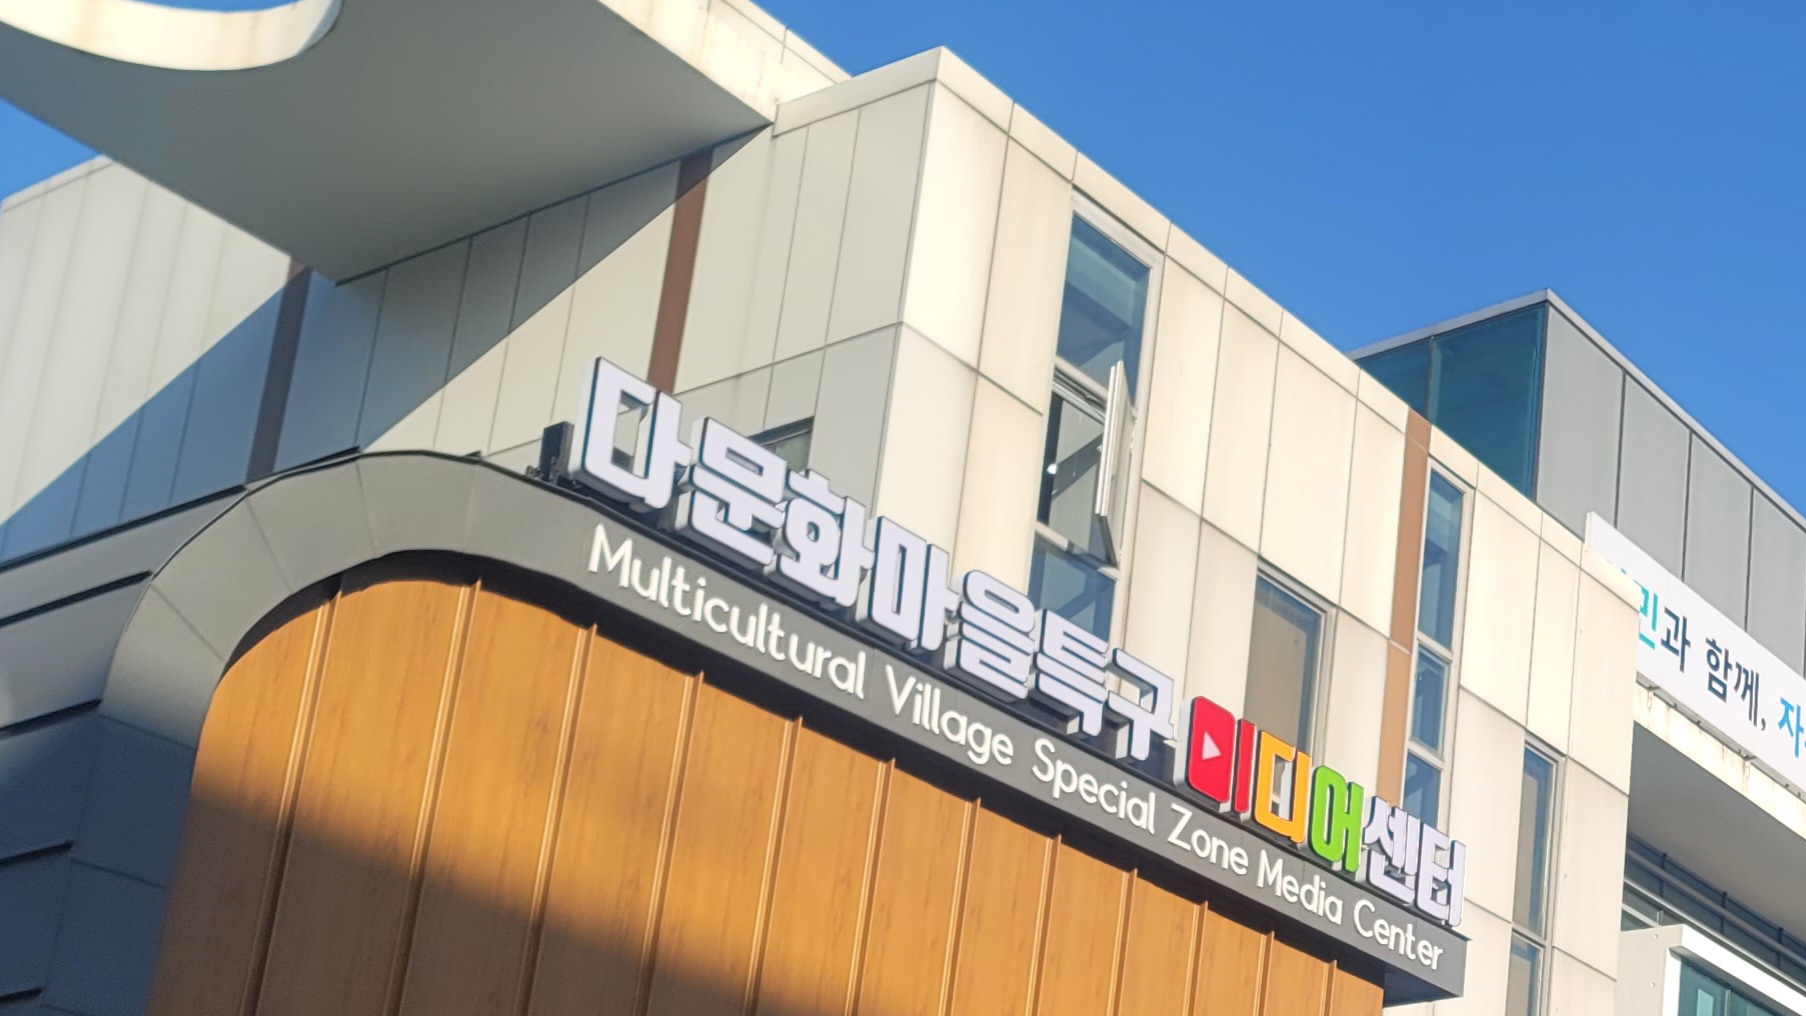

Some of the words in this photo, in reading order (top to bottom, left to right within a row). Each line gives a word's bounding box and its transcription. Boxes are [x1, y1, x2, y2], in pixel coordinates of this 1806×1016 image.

[587, 523, 866, 699] Multicultural
[885, 664, 1014, 765] Village
[1032, 738, 1156, 835] Special
[1168, 803, 1248, 875] Zone
[1257, 850, 1343, 926] Media
[1354, 900, 1442, 970] Center
[1632, 578, 1691, 673] 민과
[1705, 637, 1766, 732] 함께,
